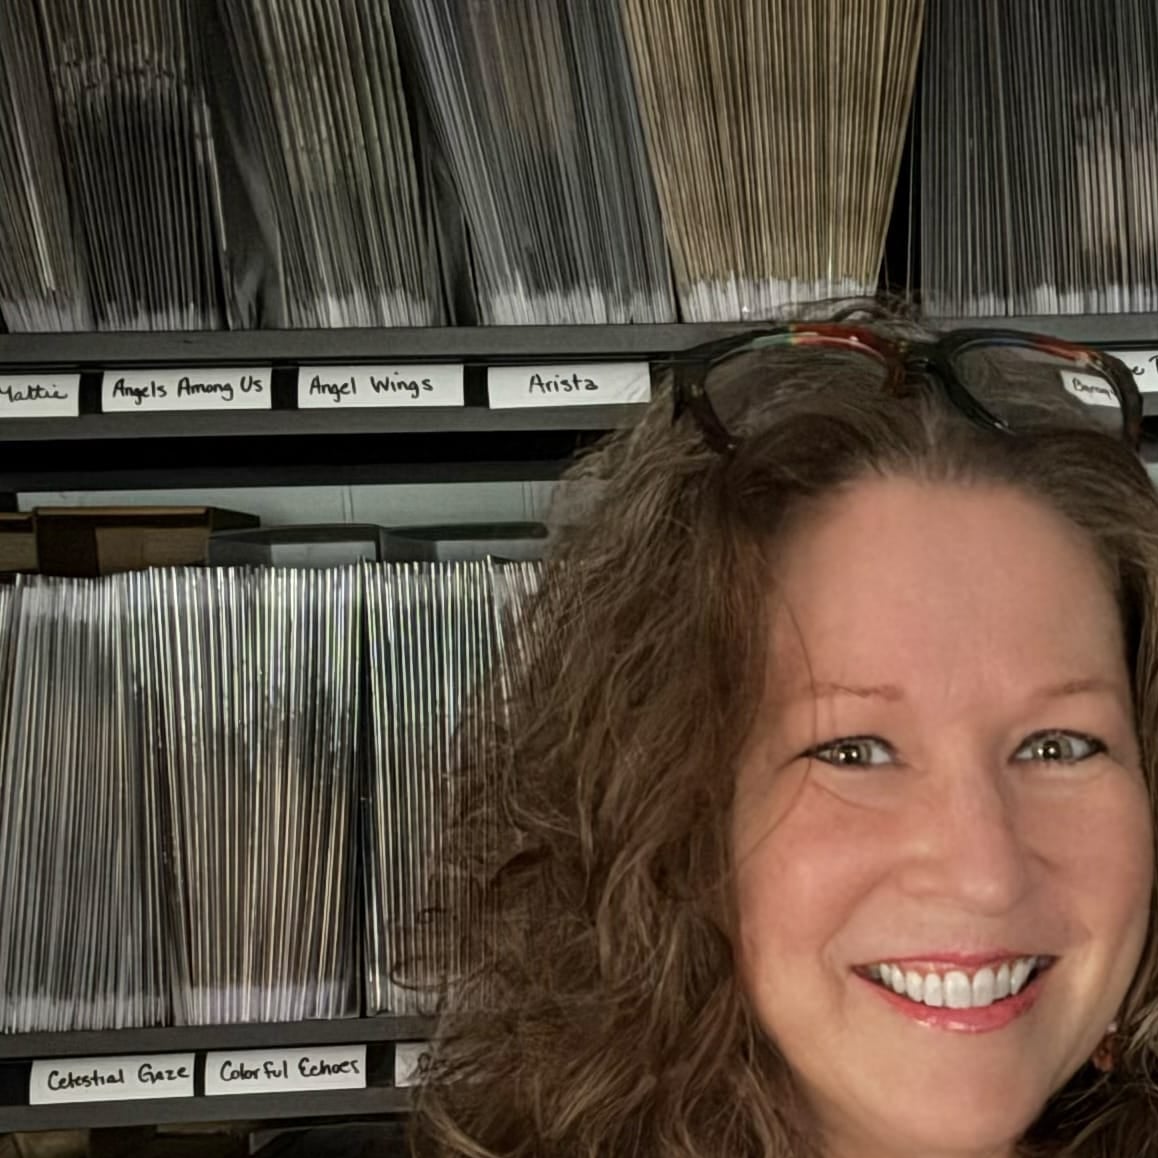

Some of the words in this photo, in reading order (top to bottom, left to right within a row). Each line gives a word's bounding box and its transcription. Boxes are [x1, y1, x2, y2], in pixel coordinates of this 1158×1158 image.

[112, 378, 168, 405] Angels
[177, 376, 234, 402] Among
[240, 375, 263, 393] Us
[309, 374, 358, 402] Angel
[369, 371, 434, 399] Wings
[528, 373, 600, 396] Arista
[47, 1069, 125, 1091] Celestial
[138, 1063, 191, 1083] Gaze
[219, 1058, 290, 1082] Colorful
[298, 1057, 361, 1077] Echoes
